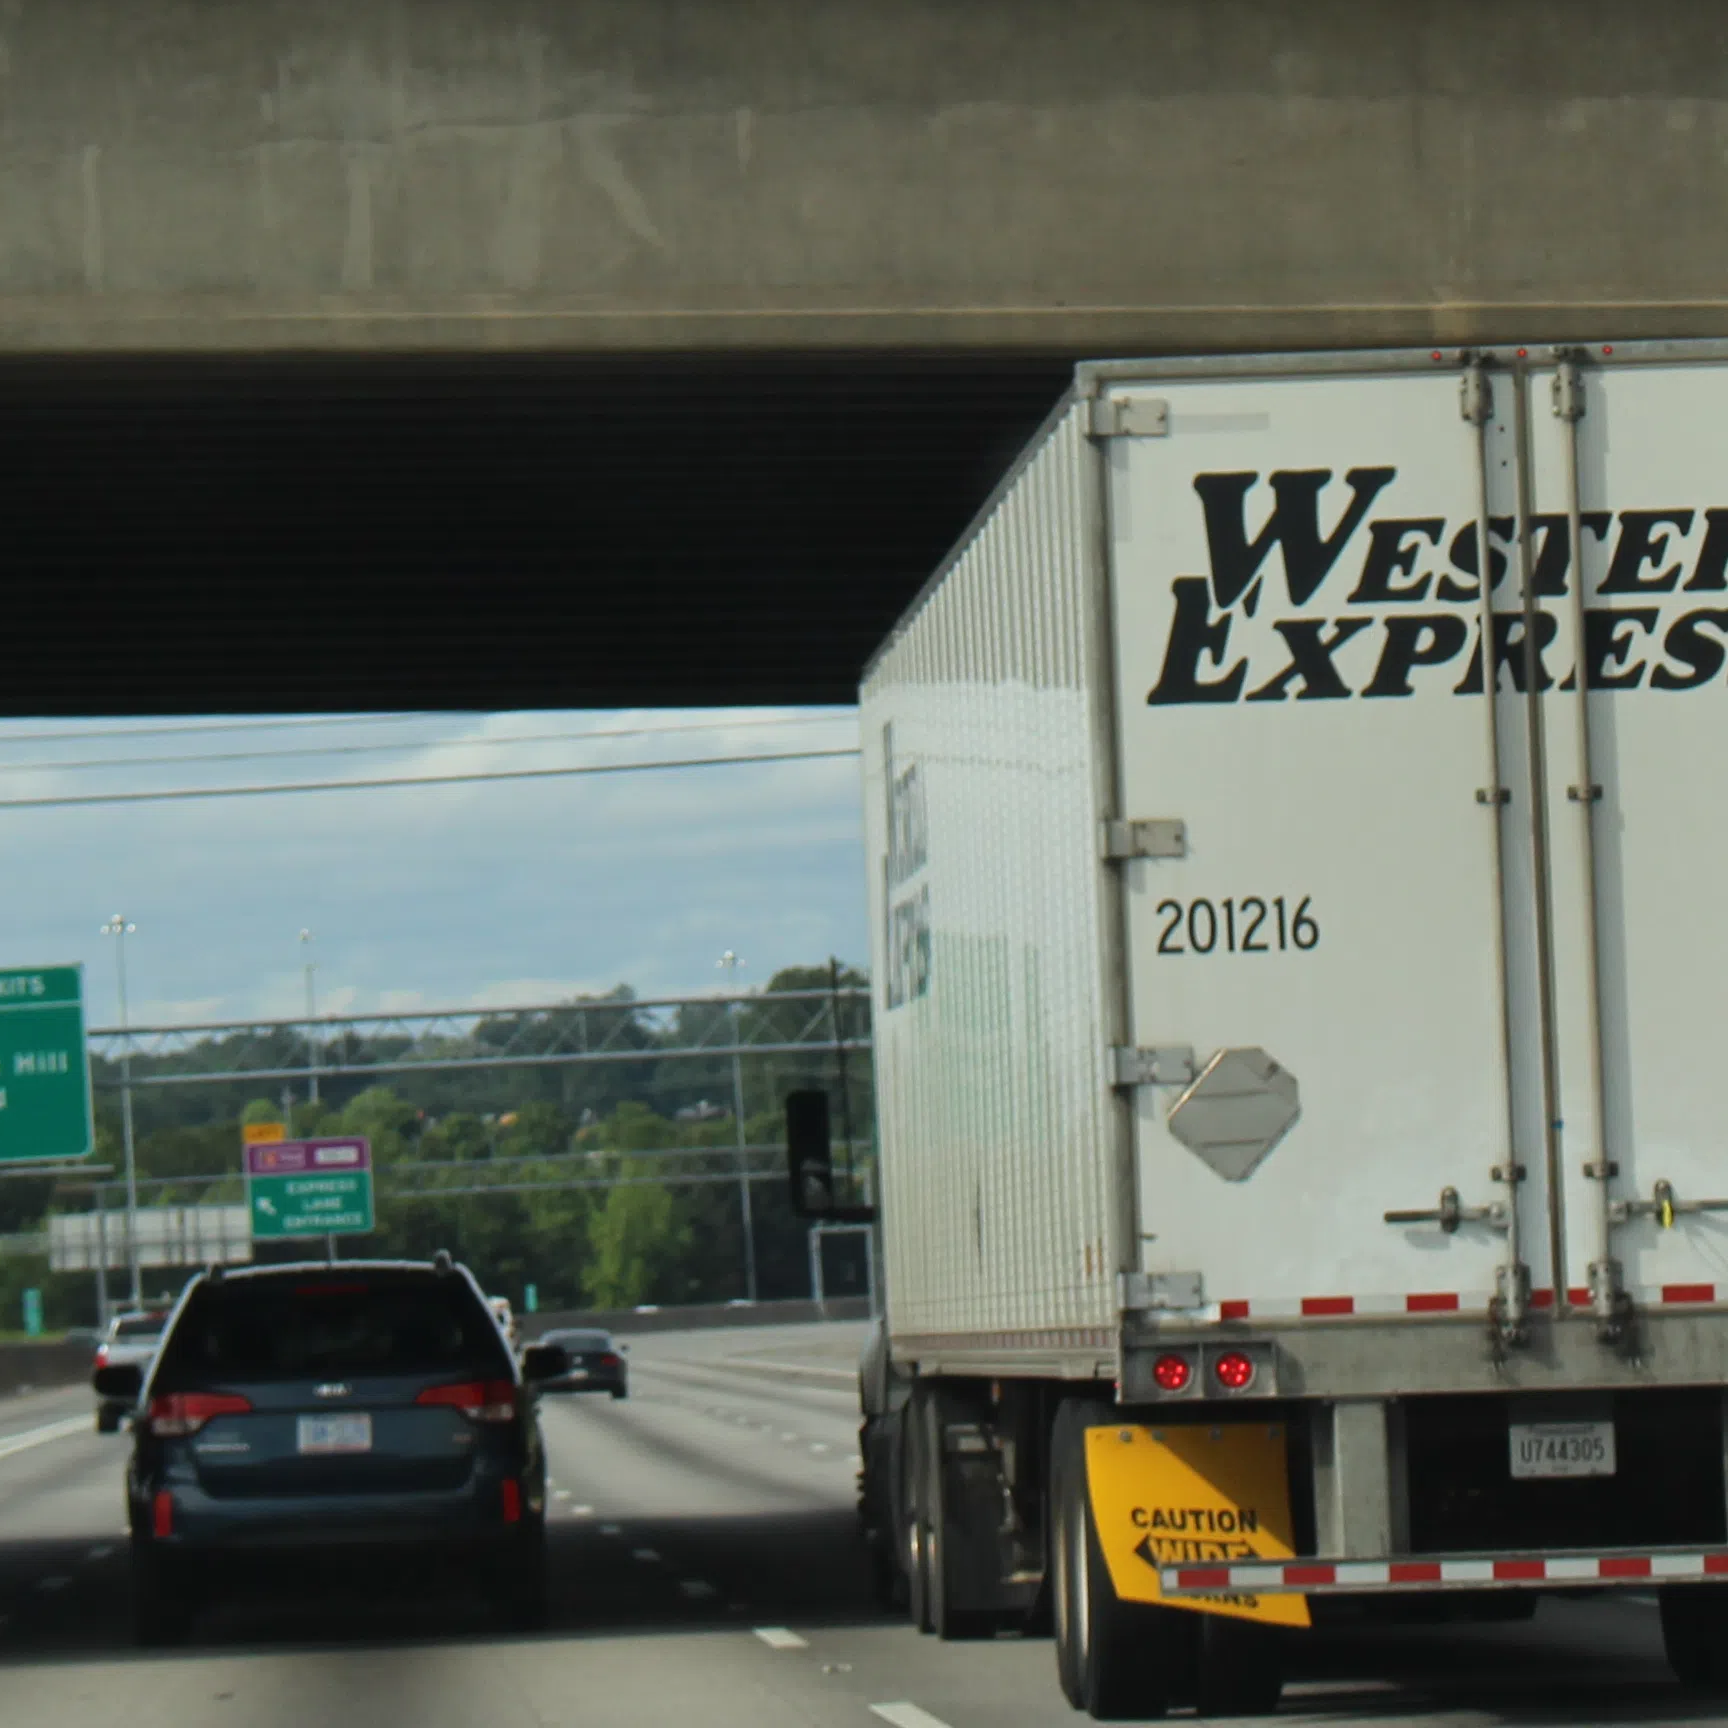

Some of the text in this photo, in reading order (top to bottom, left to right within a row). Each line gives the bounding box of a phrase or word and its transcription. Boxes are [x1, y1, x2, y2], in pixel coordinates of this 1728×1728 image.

[1156, 895, 1319, 955] 201216
[14, 1051, 68, 1076] Hill
[1520, 1436, 1605, 1464] U744305
[1131, 1506, 1258, 1533] CAUTION
